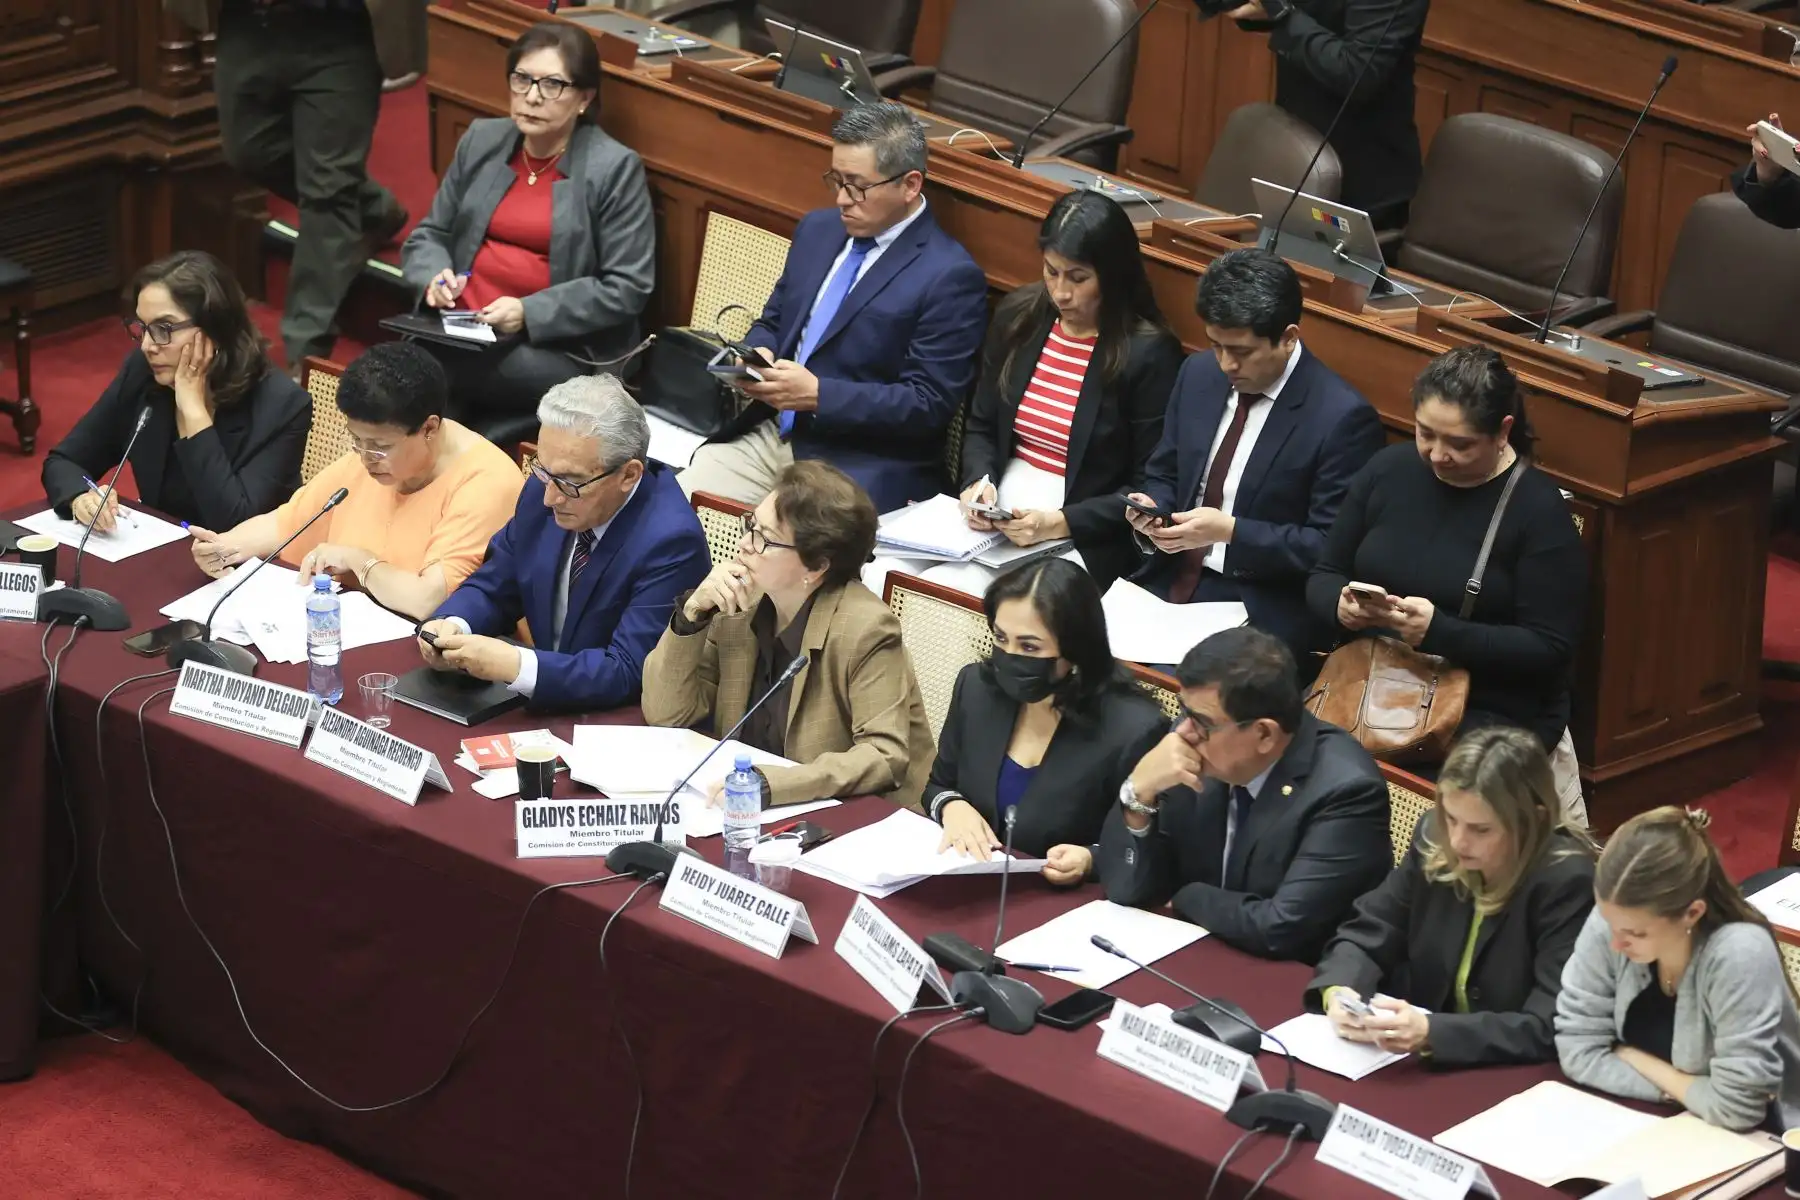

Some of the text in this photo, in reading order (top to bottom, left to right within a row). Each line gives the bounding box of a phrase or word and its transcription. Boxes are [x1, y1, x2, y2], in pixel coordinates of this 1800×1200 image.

[182, 666, 310, 720] MARTHA MOYANO DELGADO
[212, 701, 267, 722] Miembro Titular
[319, 710, 423, 772] ALEJANDRO AGUINAGA RECUENCO
[339, 746, 388, 773] Miembro Titular
[522, 802, 680, 829] GLADYS ECHAIZ RAMOS
[570, 829, 644, 838] Miembro Titular
[680, 865, 791, 927] HEIDY JUÁREZ CALLE
[701, 898, 756, 928] Miembro Titular
[866, 919, 900, 959] WILLIAMS
[896, 946, 924, 981] ZAPATA
